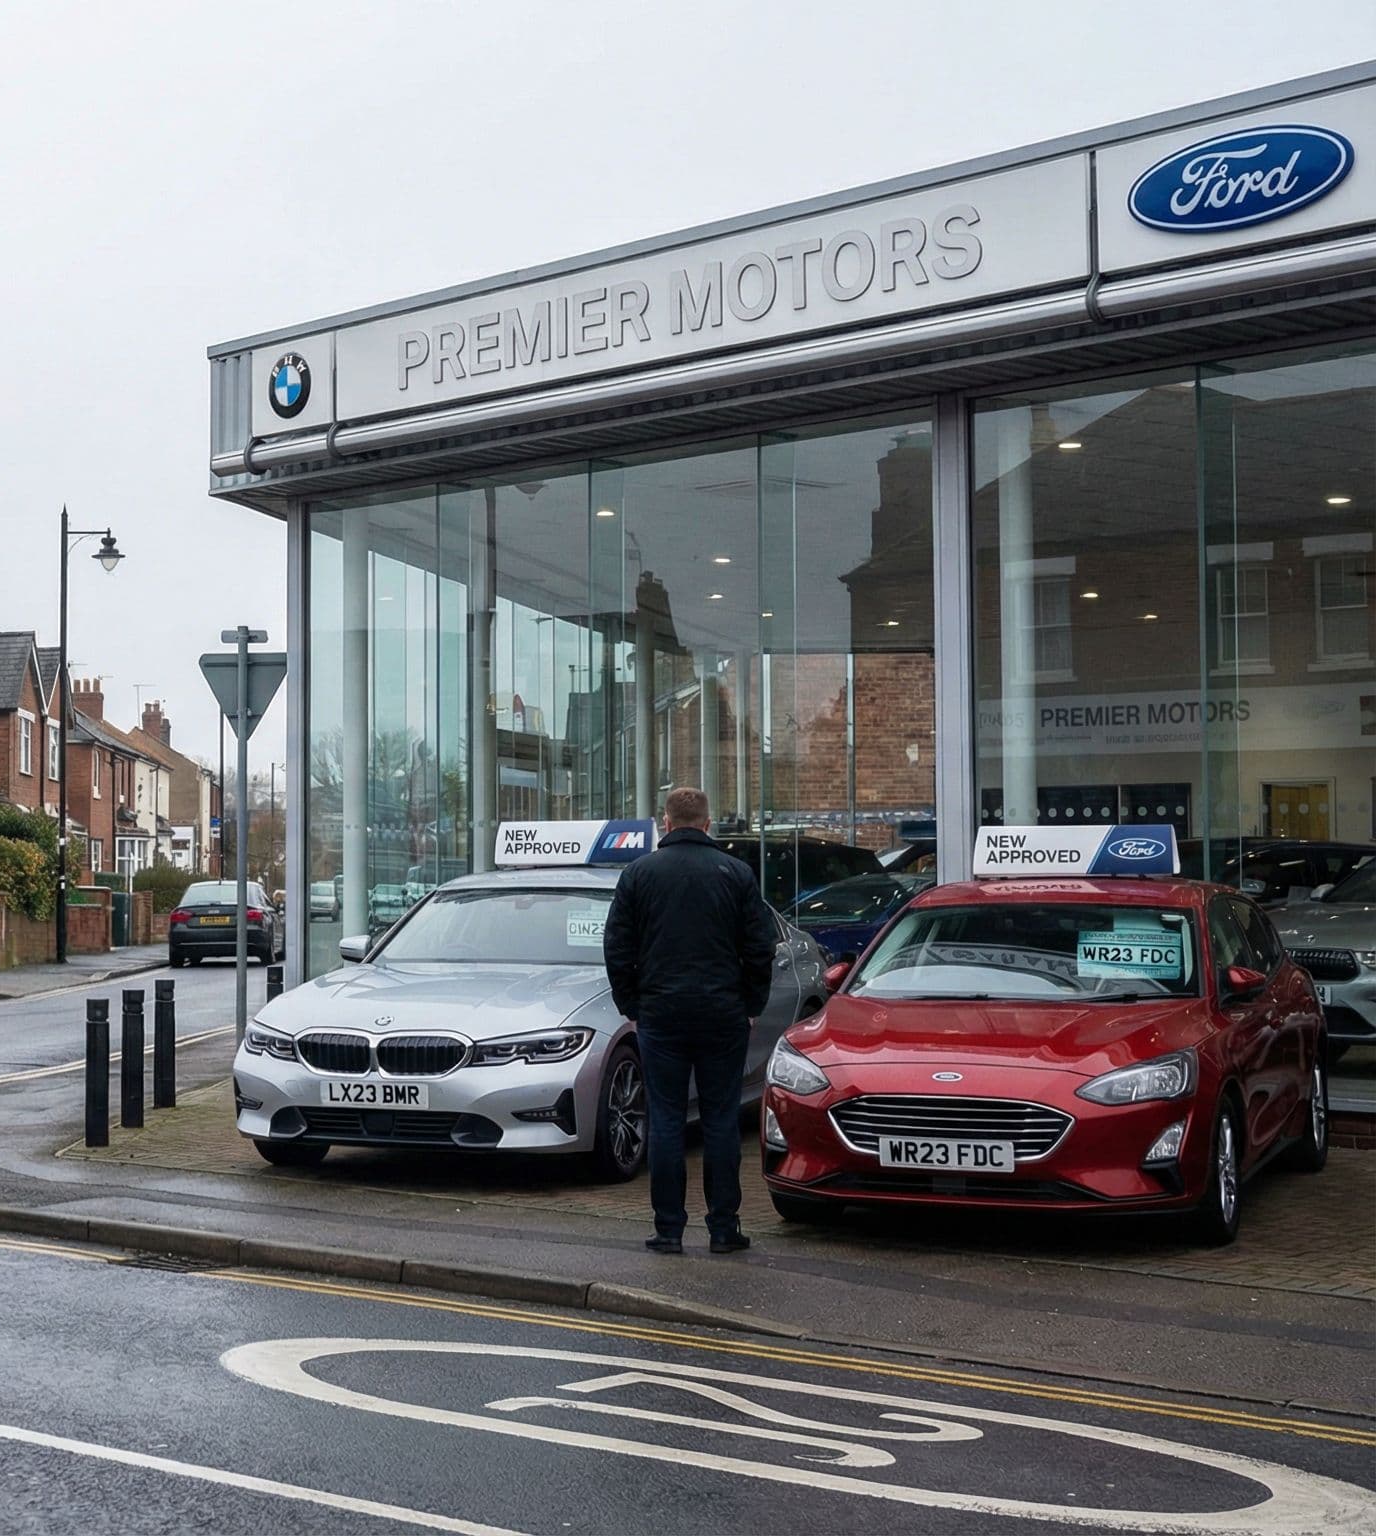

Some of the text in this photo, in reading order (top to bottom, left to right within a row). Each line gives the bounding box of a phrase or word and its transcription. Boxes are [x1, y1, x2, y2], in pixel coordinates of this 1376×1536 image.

[1170, 143, 1302, 216] Ford
[398, 203, 983, 391] PREMIER MOTORS
[1040, 704, 1140, 728] PREMIER
[1148, 700, 1251, 724] MOTORS
[504, 829, 537, 841] NEW
[986, 835, 1027, 848] NEW
[504, 842, 581, 855] APPROVED
[986, 850, 1081, 864] APPROVED
[1119, 841, 1155, 857] Ford
[1083, 947, 1176, 964] WR23 FDC
[329, 1083, 420, 1105] LX23 BMR
[889, 1140, 1004, 1167] WR23 FDC
